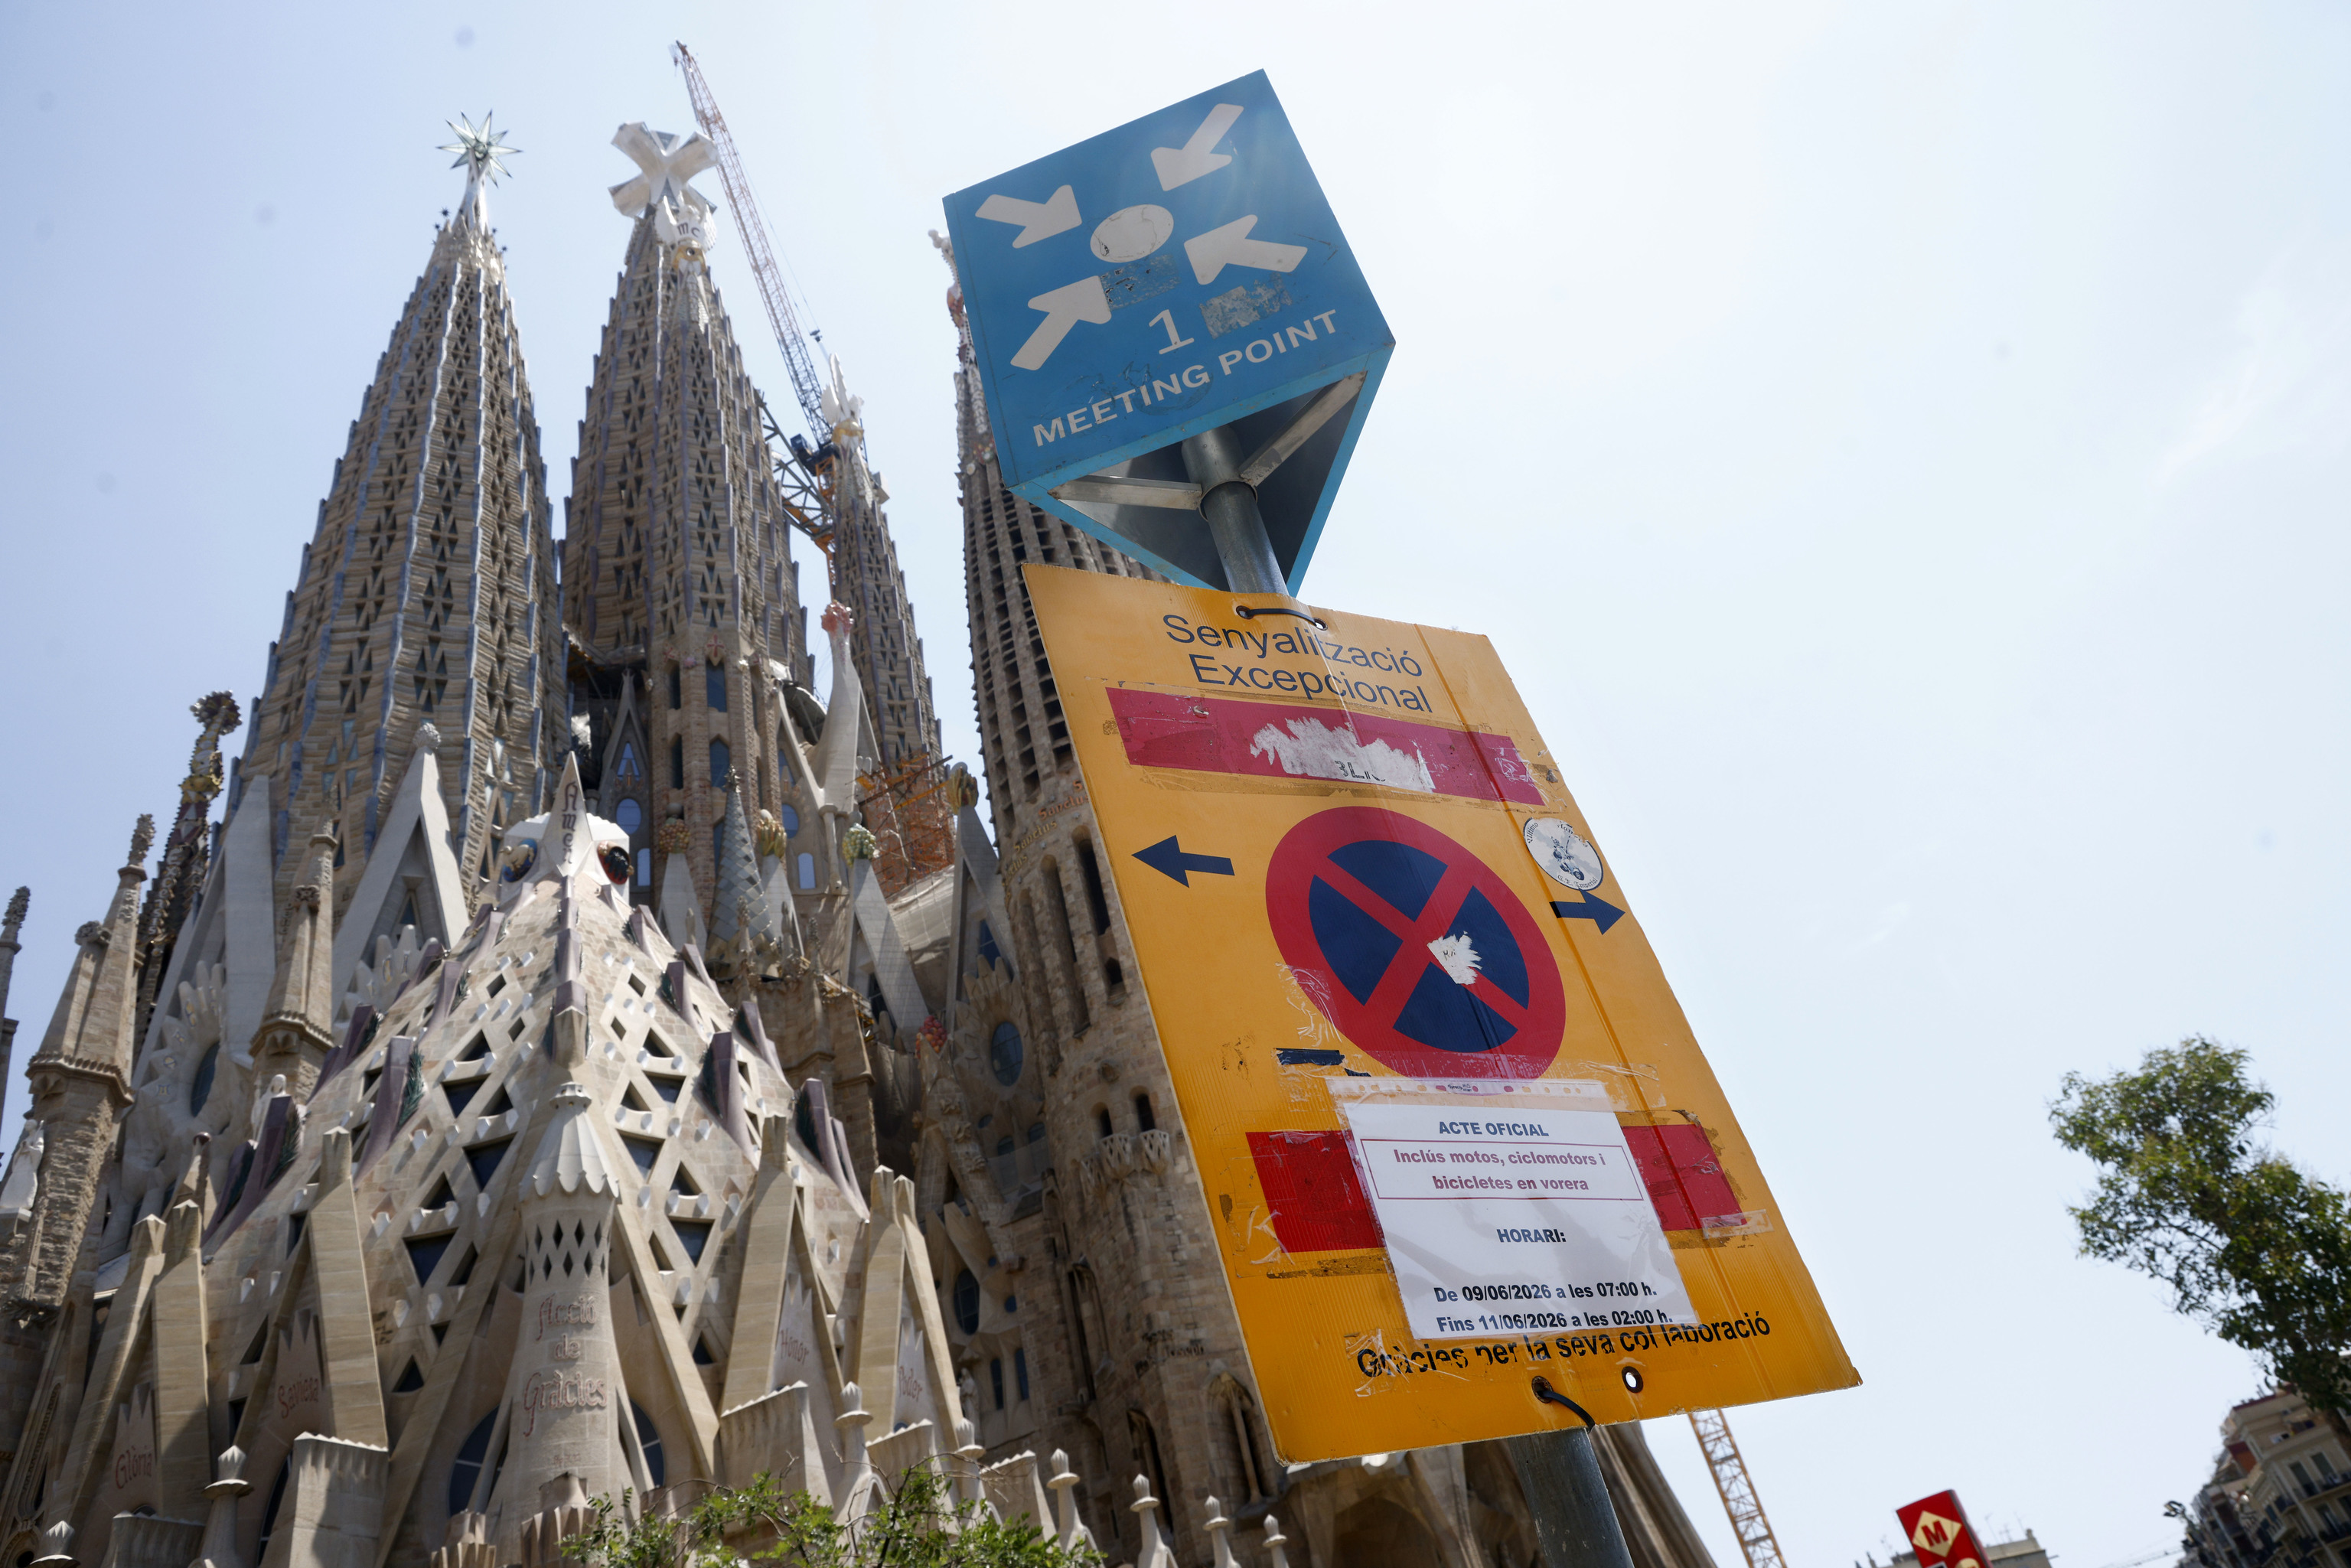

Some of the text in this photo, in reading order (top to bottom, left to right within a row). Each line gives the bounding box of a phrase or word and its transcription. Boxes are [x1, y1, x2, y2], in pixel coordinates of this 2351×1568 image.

[1149, 309, 1195, 354] 1
[1032, 364, 1210, 448] MEETING
[1218, 309, 1336, 376] POINT
[1162, 614, 1423, 677] Senyalització
[1189, 654, 1433, 713] Excepcional
[1013, 820, 1058, 854] Sanctus
[1440, 1122, 1550, 1137] ACTE OFICIAL
[1394, 1149, 1606, 1167] Inclús motos, ciclomotors i
[1432, 1176, 1590, 1191] bicicletes en vorera
[1497, 1228, 1567, 1243] HORARI:
[1434, 1281, 1658, 1302] De 09/06/2026 a les 07:00 h.
[536, 1292, 597, 1341] Acció
[1436, 1309, 1674, 1332] Fins 11/06/2026 a les 02:00 h.
[553, 1334, 582, 1360] de
[1523, 1335, 1552, 1362] la
[1556, 1334, 1616, 1358] seva
[523, 1371, 608, 1437] Gràcies
[1921, 1520, 1949, 1547] M
